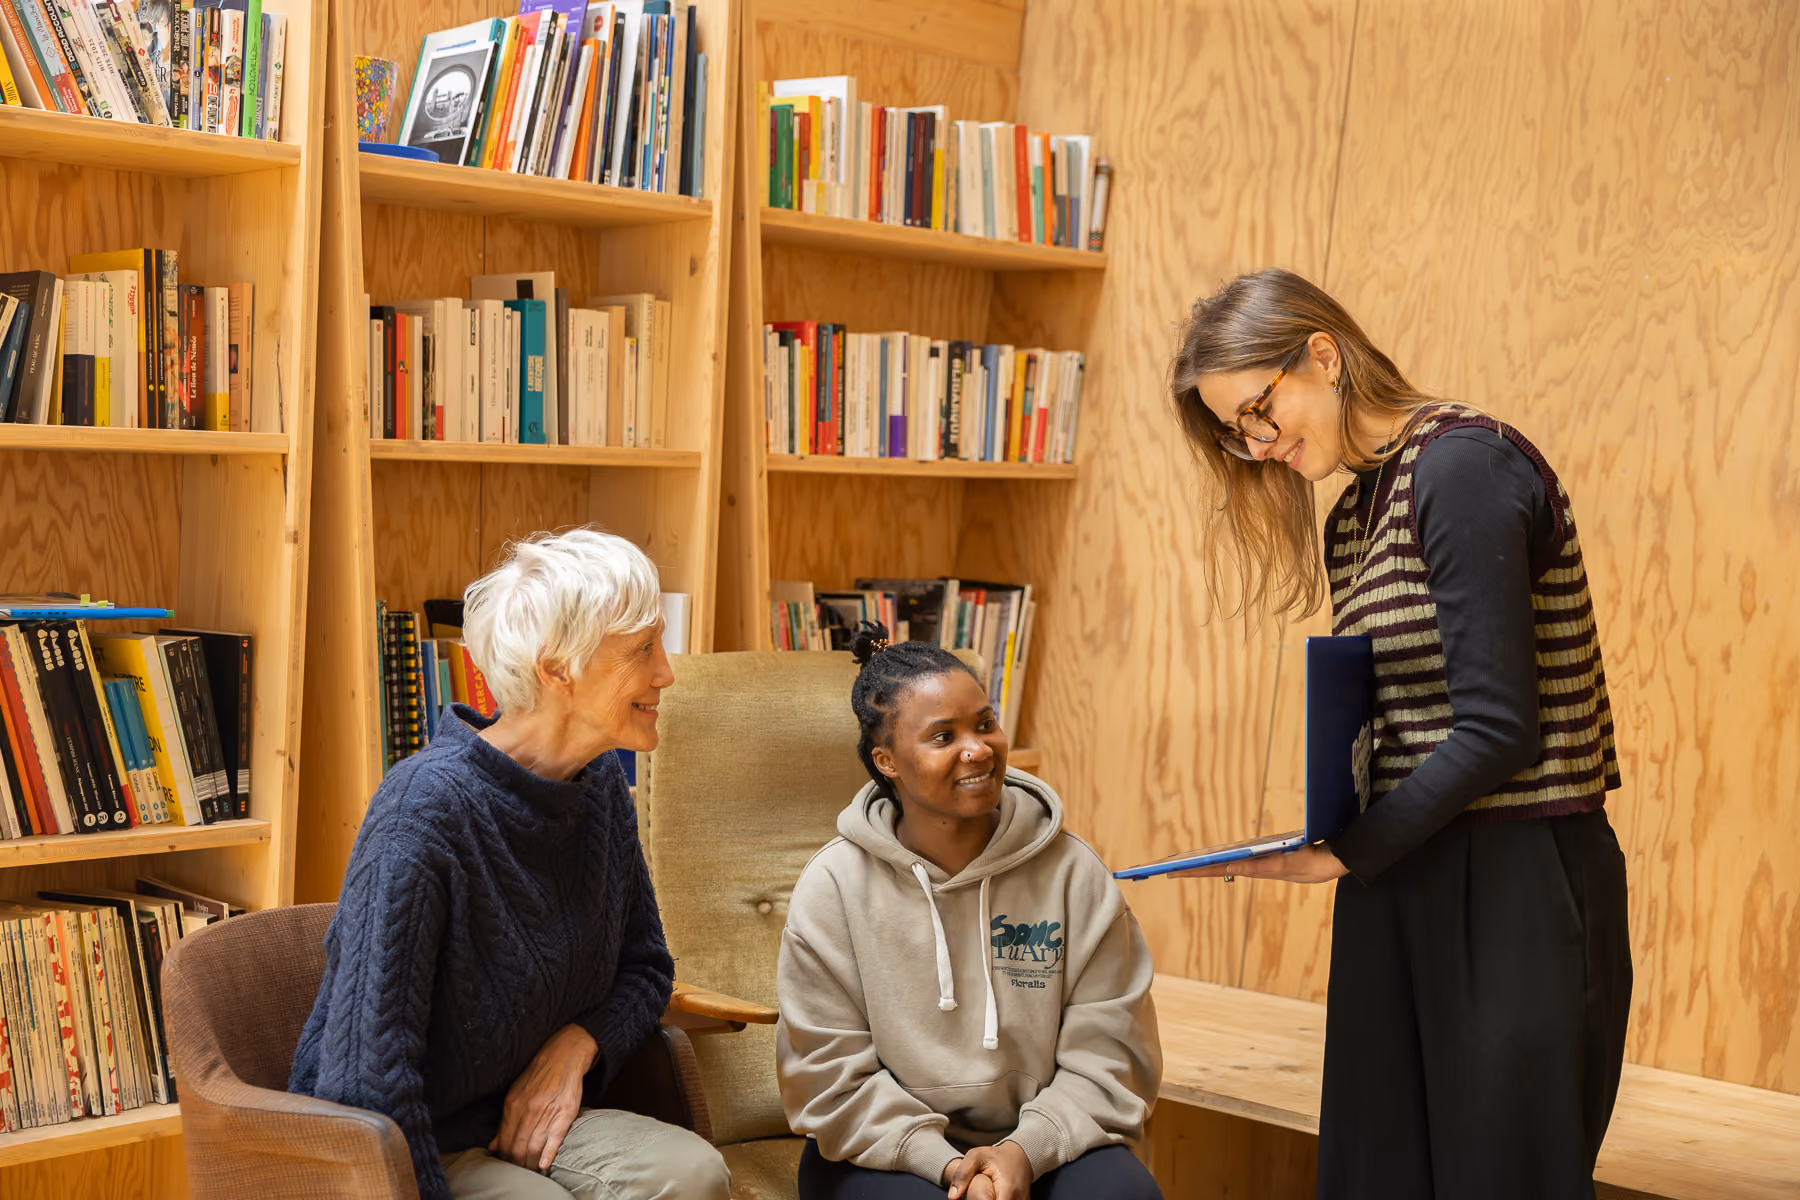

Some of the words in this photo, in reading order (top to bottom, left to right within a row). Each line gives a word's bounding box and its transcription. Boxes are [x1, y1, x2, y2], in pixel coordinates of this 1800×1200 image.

[88, 38, 98, 54] 2025
[100, 40, 108, 57] 2025
[128, 285, 136, 316] MIRACLE
[190, 362, 196, 370] de
[190, 388, 196, 398] Le
